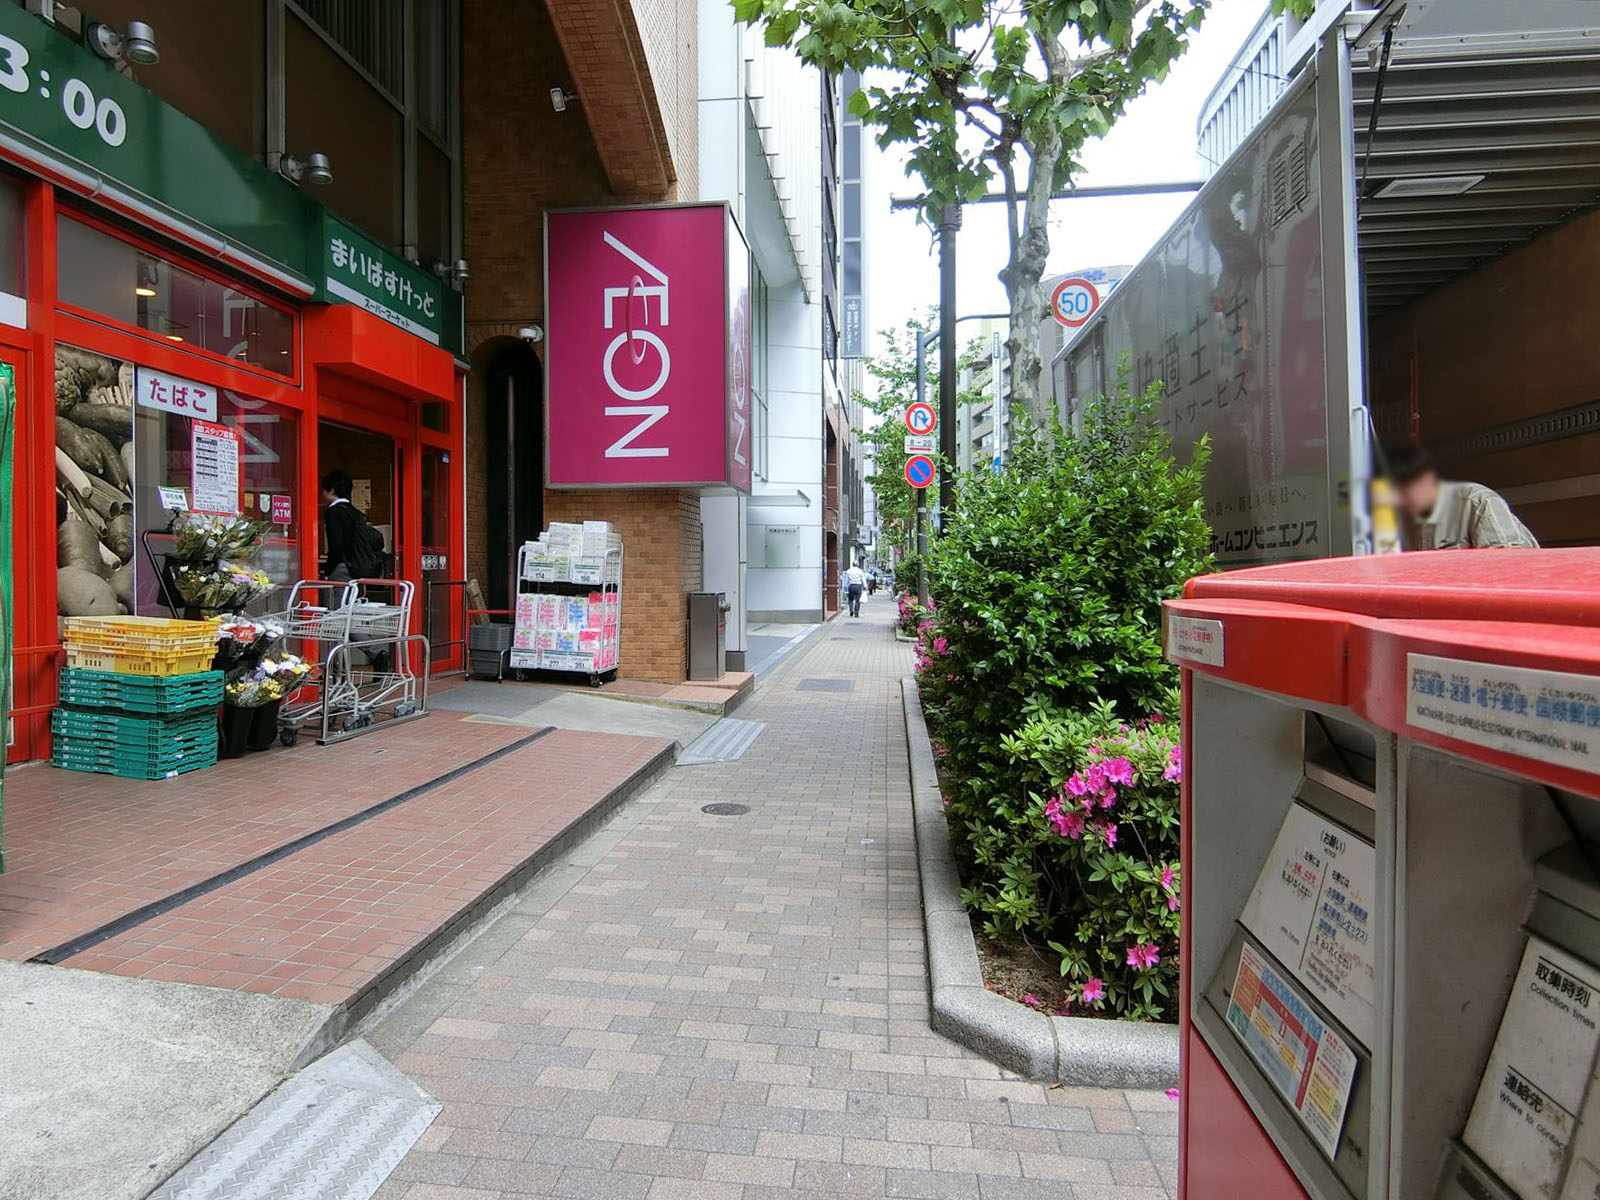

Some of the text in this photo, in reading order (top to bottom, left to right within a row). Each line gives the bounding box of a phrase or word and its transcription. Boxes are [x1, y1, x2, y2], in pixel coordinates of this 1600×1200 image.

[330, 237, 436, 319] まいばすけっと
[363, 298, 411, 329] スーパーマーケット
[1061, 292, 1089, 314] 50
[602, 230, 671, 458] AEON
[149, 377, 207, 413] たばこ
[274, 509, 290, 517] ATM
[1535, 962, 1592, 1008] 取集時刻
[1530, 982, 1596, 1030] Collection times
[1499, 1090, 1523, 1116] Where
[1525, 1113, 1534, 1125] to
[1503, 1071, 1543, 1113] 連絡先
